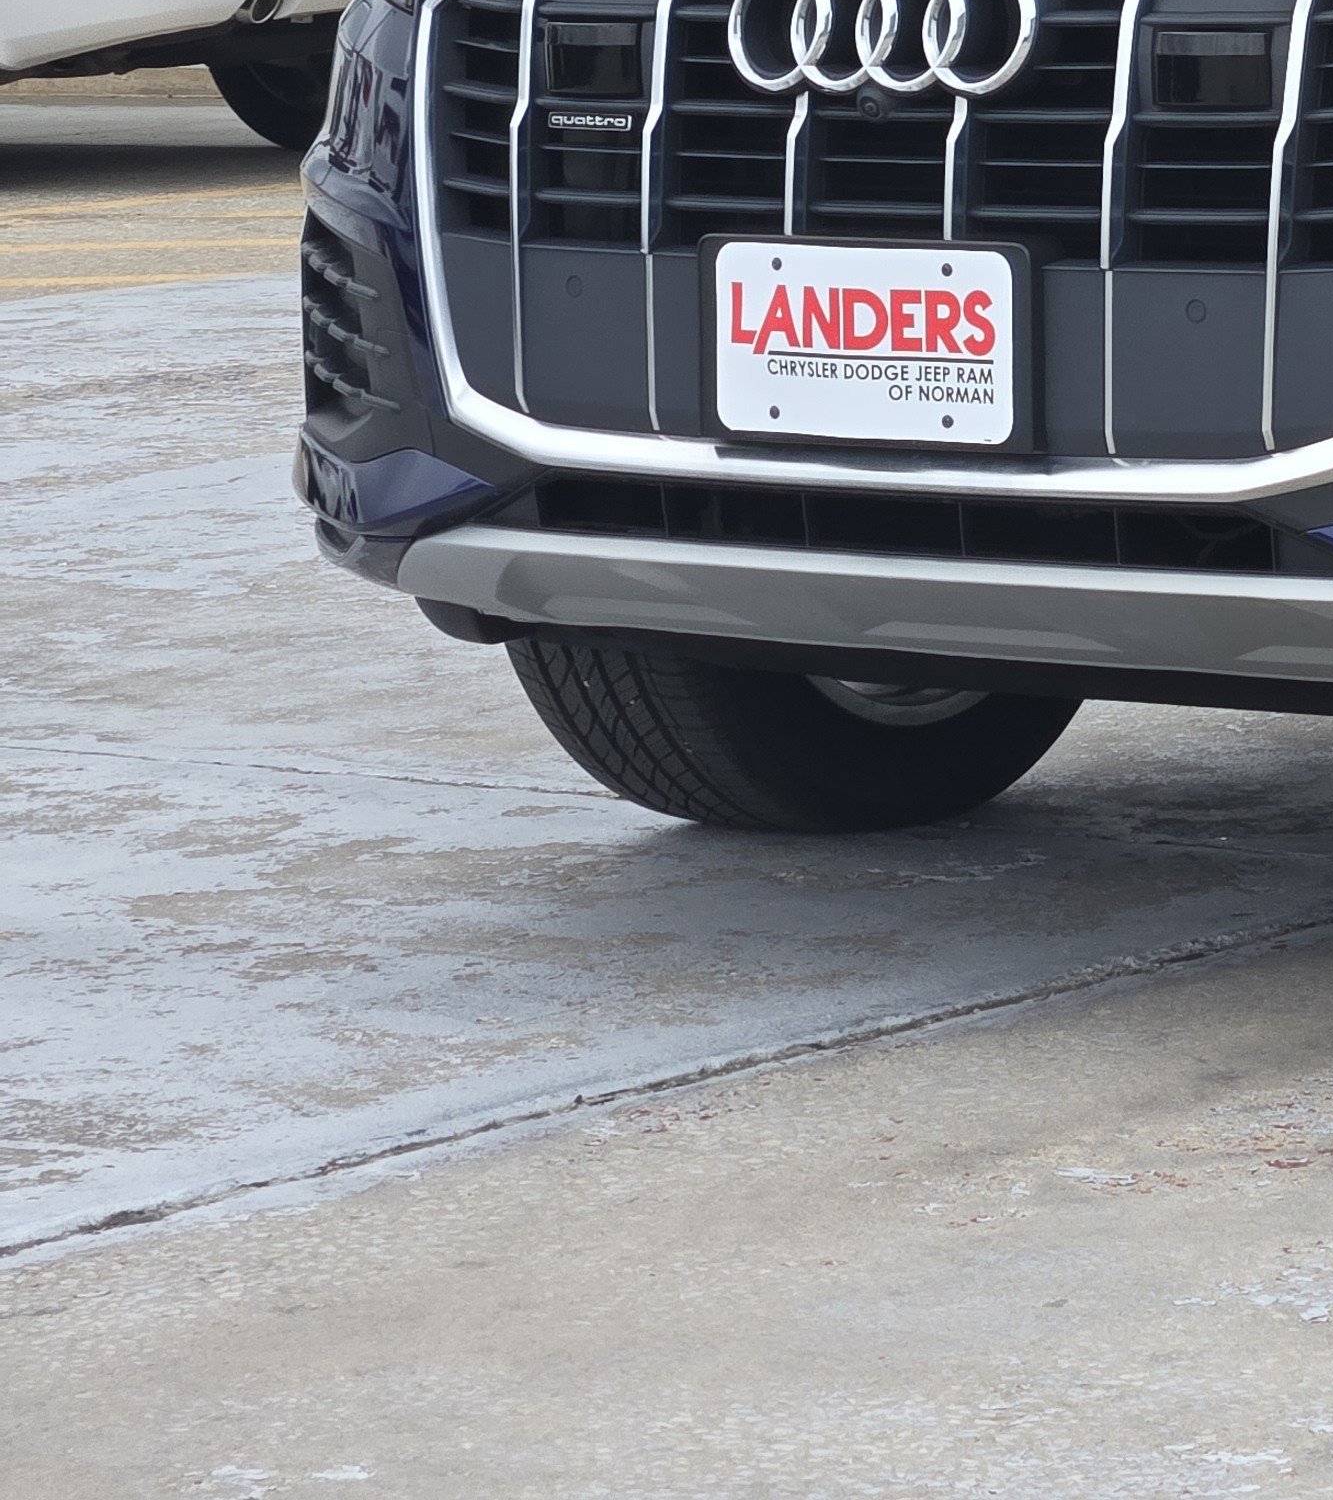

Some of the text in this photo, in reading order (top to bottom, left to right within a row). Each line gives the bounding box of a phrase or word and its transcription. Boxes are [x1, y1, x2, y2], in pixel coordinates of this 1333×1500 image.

[551, 115, 627, 127] quattro
[731, 282, 996, 356] LANDERS
[767, 359, 994, 385] CHRYSLER DODGE JEEP RAM
[888, 385, 995, 405] OF NORMAN
